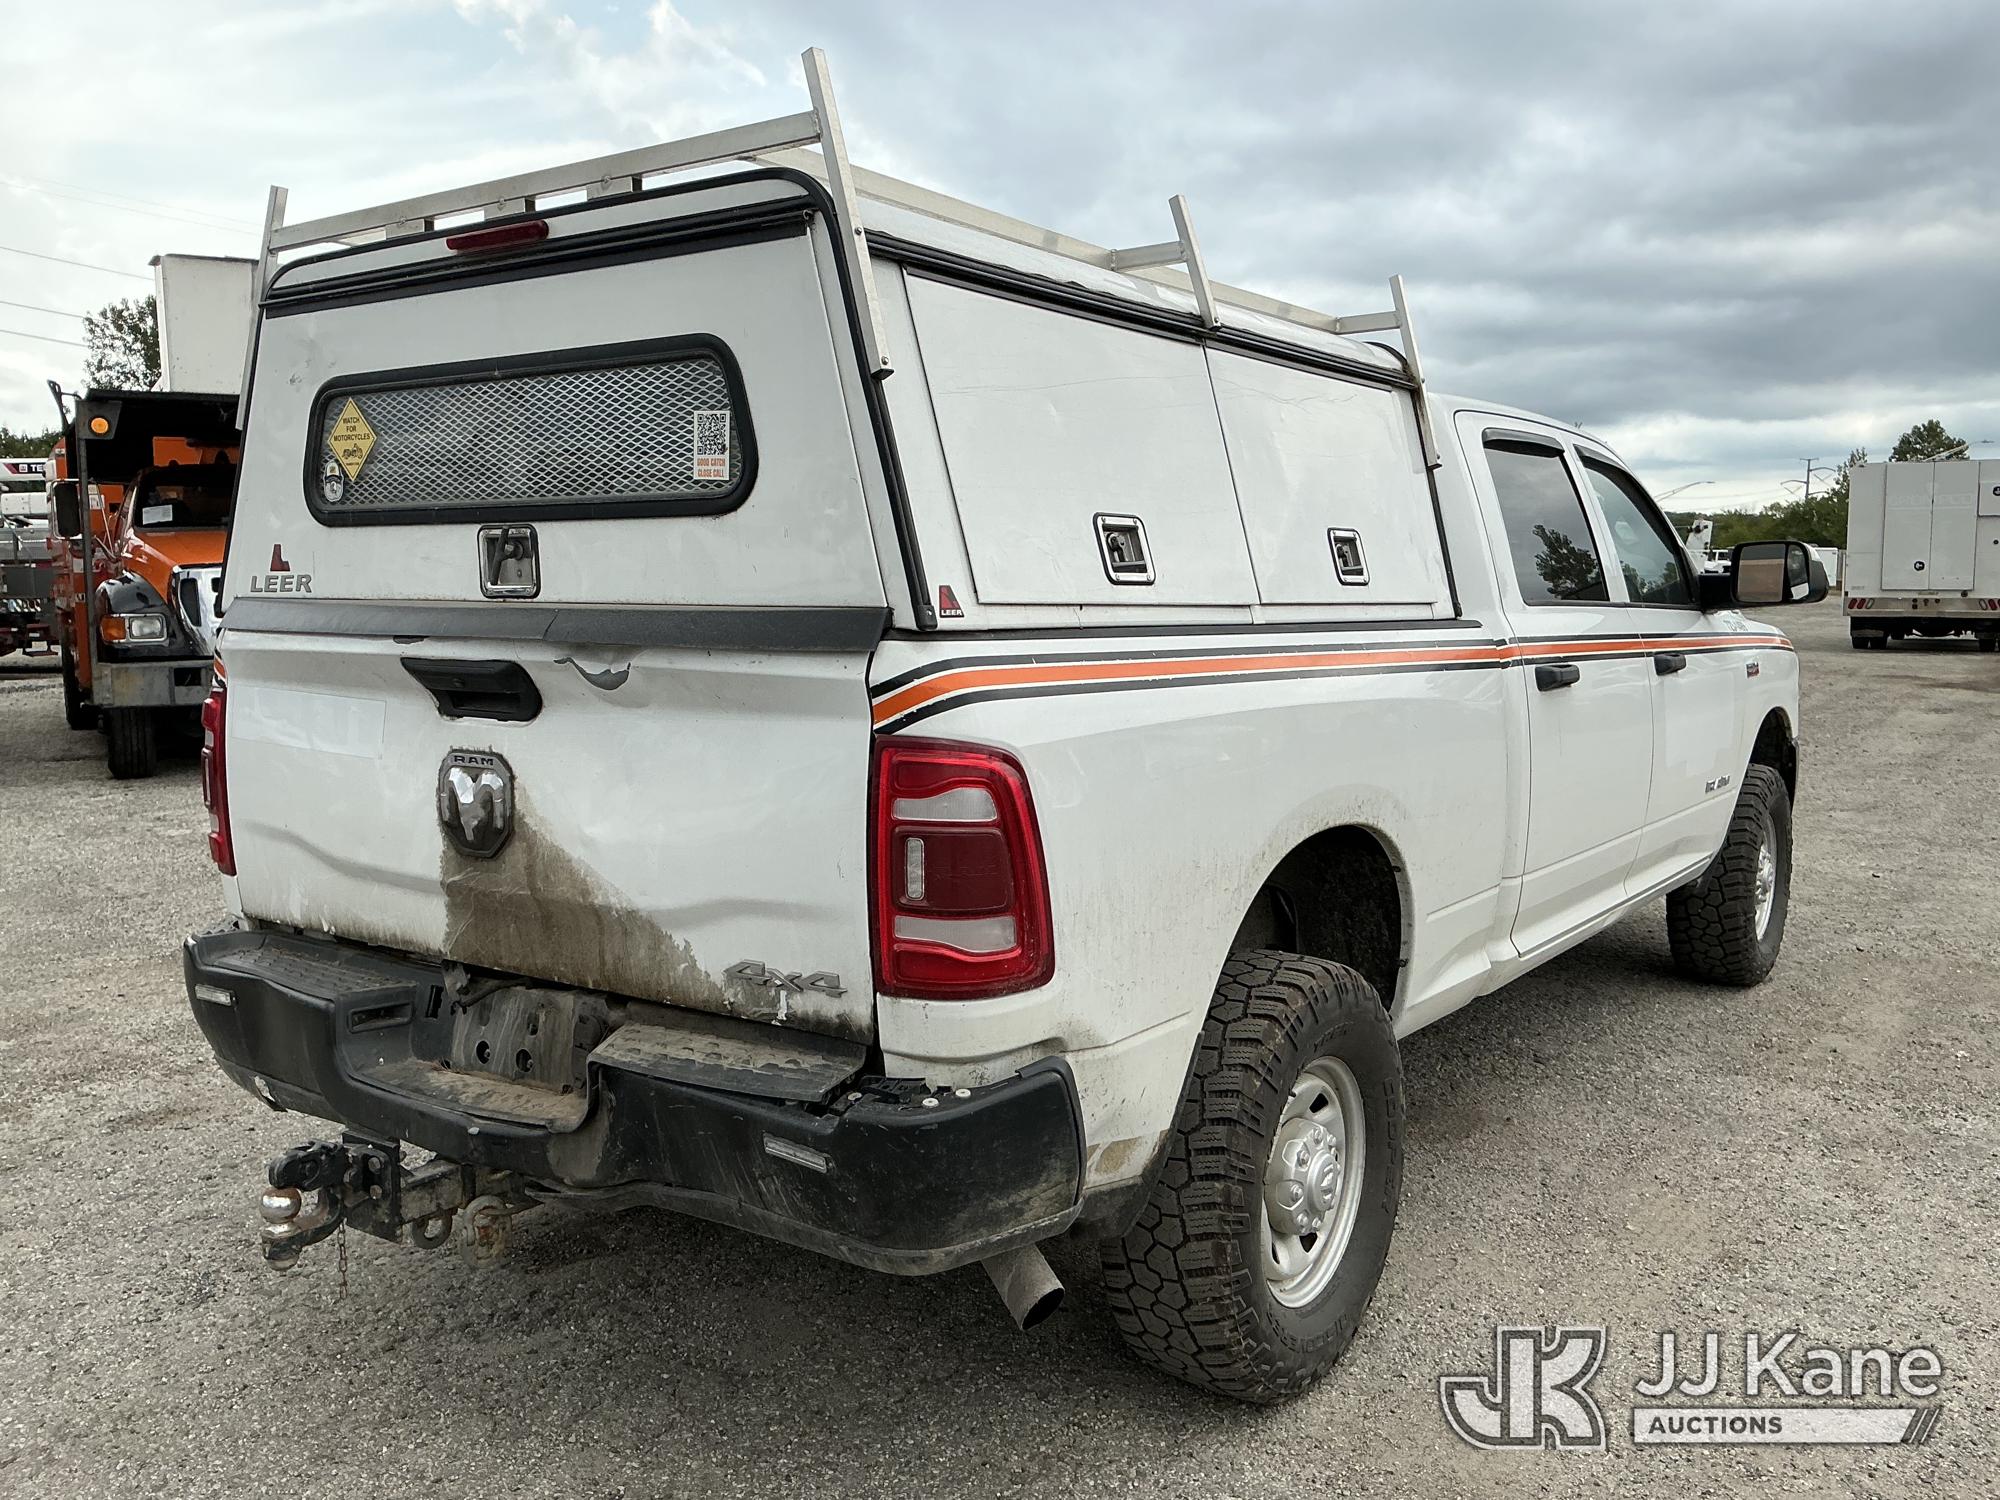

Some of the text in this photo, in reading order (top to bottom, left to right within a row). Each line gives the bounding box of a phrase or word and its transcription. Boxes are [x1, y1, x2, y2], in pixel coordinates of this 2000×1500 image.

[342, 416, 360, 424] WATCH
[333, 432, 371, 442] MOTORCYCLES
[250, 573, 312, 593] LEER
[454, 755, 494, 766] RAM
